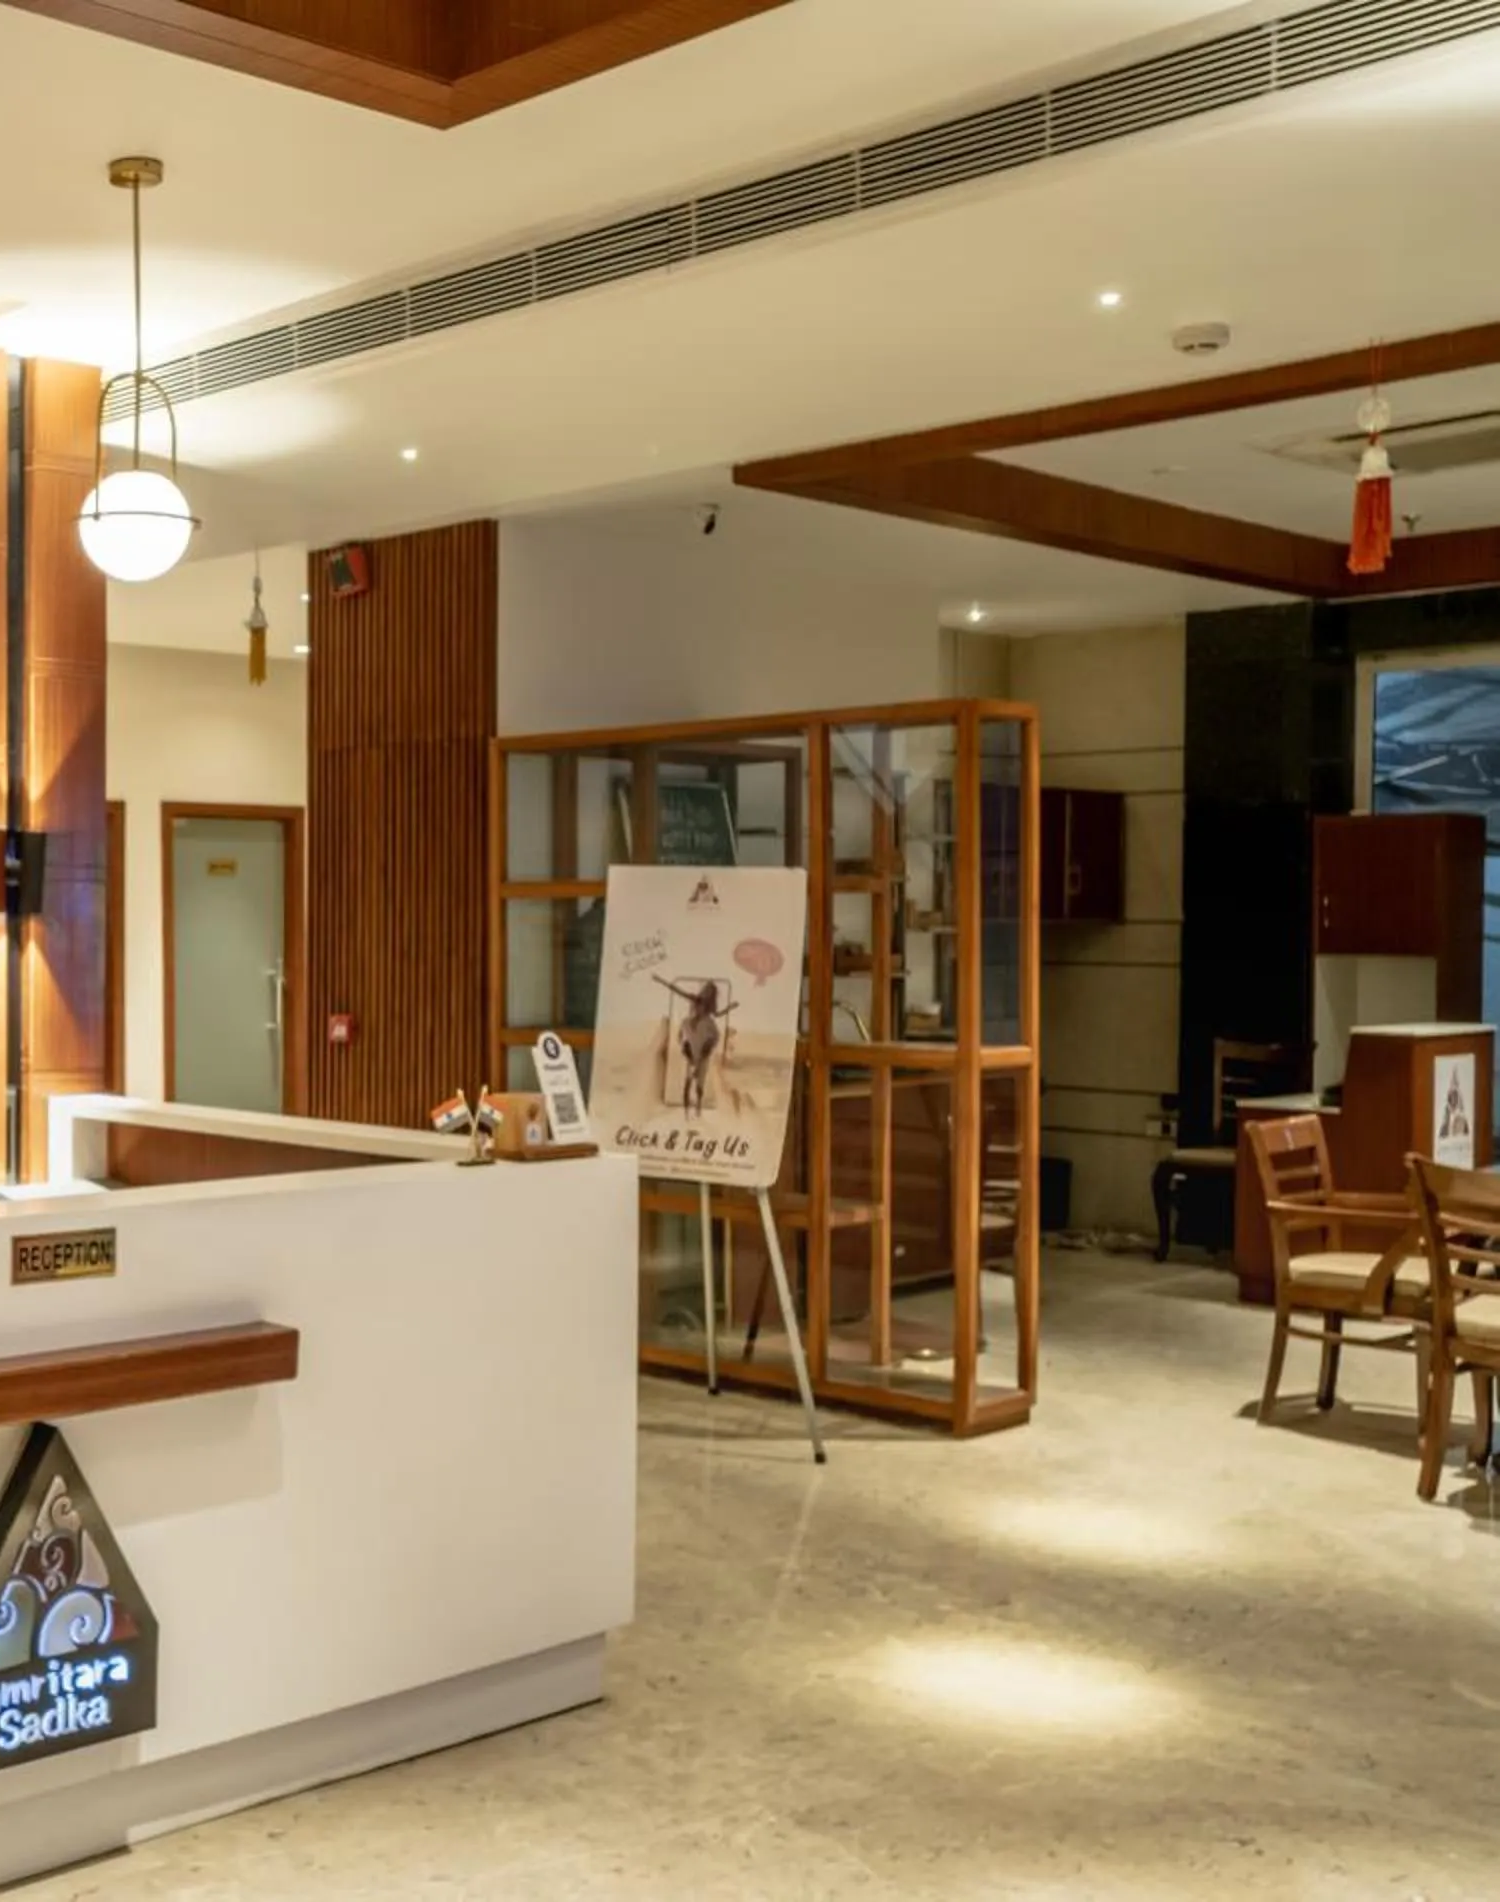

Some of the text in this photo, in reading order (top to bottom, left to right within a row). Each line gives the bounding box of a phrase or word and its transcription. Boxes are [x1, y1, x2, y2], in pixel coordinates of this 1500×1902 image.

[615, 1125, 749, 1160] Click & Tag Us
[19, 1240, 111, 1272] RECEPTION
